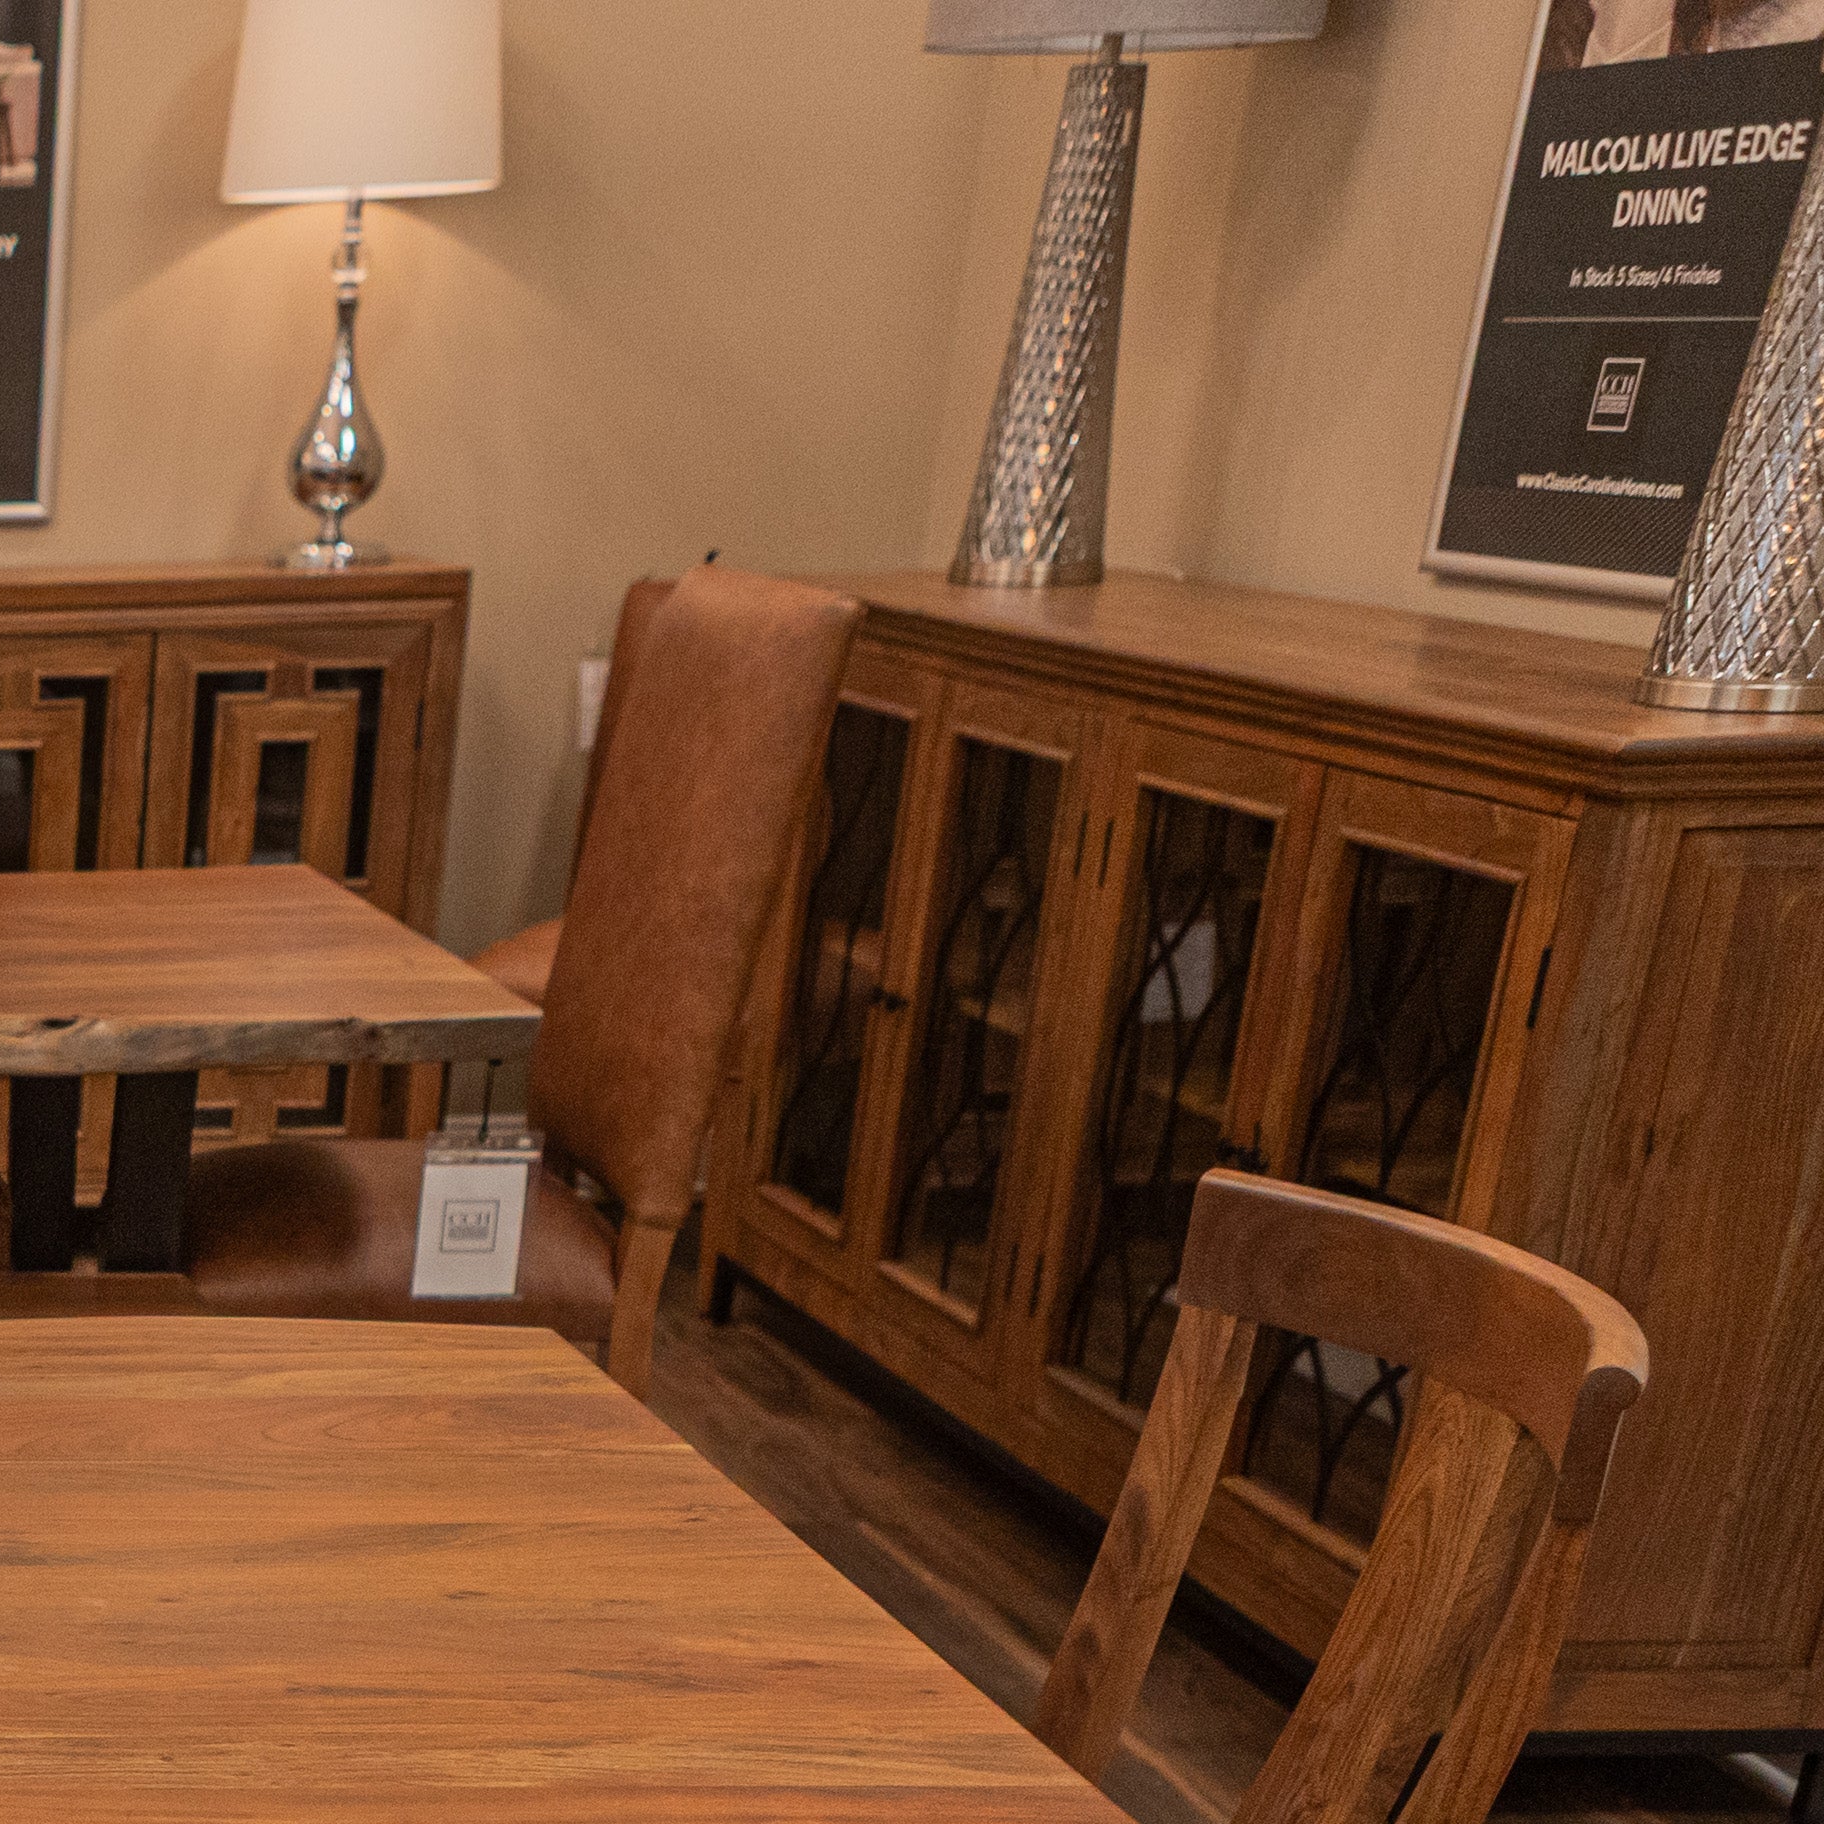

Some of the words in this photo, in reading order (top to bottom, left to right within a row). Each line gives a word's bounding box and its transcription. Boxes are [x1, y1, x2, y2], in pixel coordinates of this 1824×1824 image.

[1540, 132, 1672, 179] MALCOLM
[1672, 127, 1733, 169] LIVE
[1733, 121, 1813, 164] EDGE
[1612, 186, 1708, 228] DINING
[1569, 268, 1584, 288] In
[1584, 265, 1615, 288] Stock
[1673, 262, 1723, 286] Finishes
[1600, 373, 1637, 395] CCH
